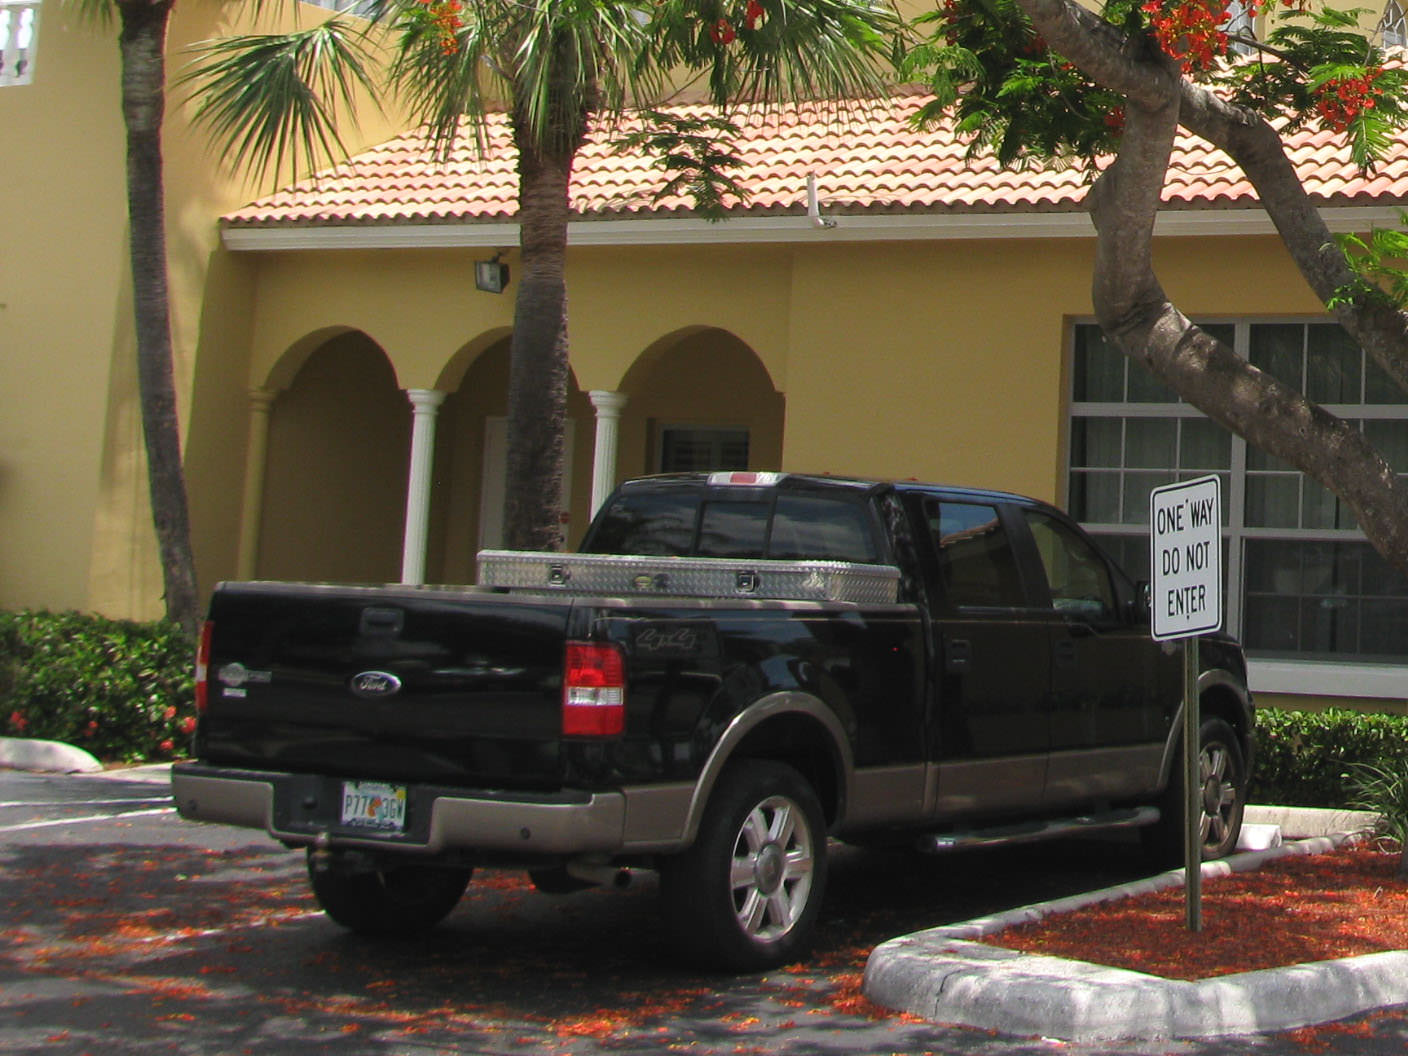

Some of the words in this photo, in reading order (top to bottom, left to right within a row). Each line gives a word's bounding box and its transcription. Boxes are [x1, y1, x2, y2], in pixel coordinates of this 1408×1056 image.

[1157, 505, 1184, 535] ONE
[1190, 497, 1215, 529] WAY
[1162, 547, 1180, 576] DO
[1186, 541, 1210, 572] NOT
[1167, 584, 1206, 617] ENTER
[359, 674, 386, 690] Ford
